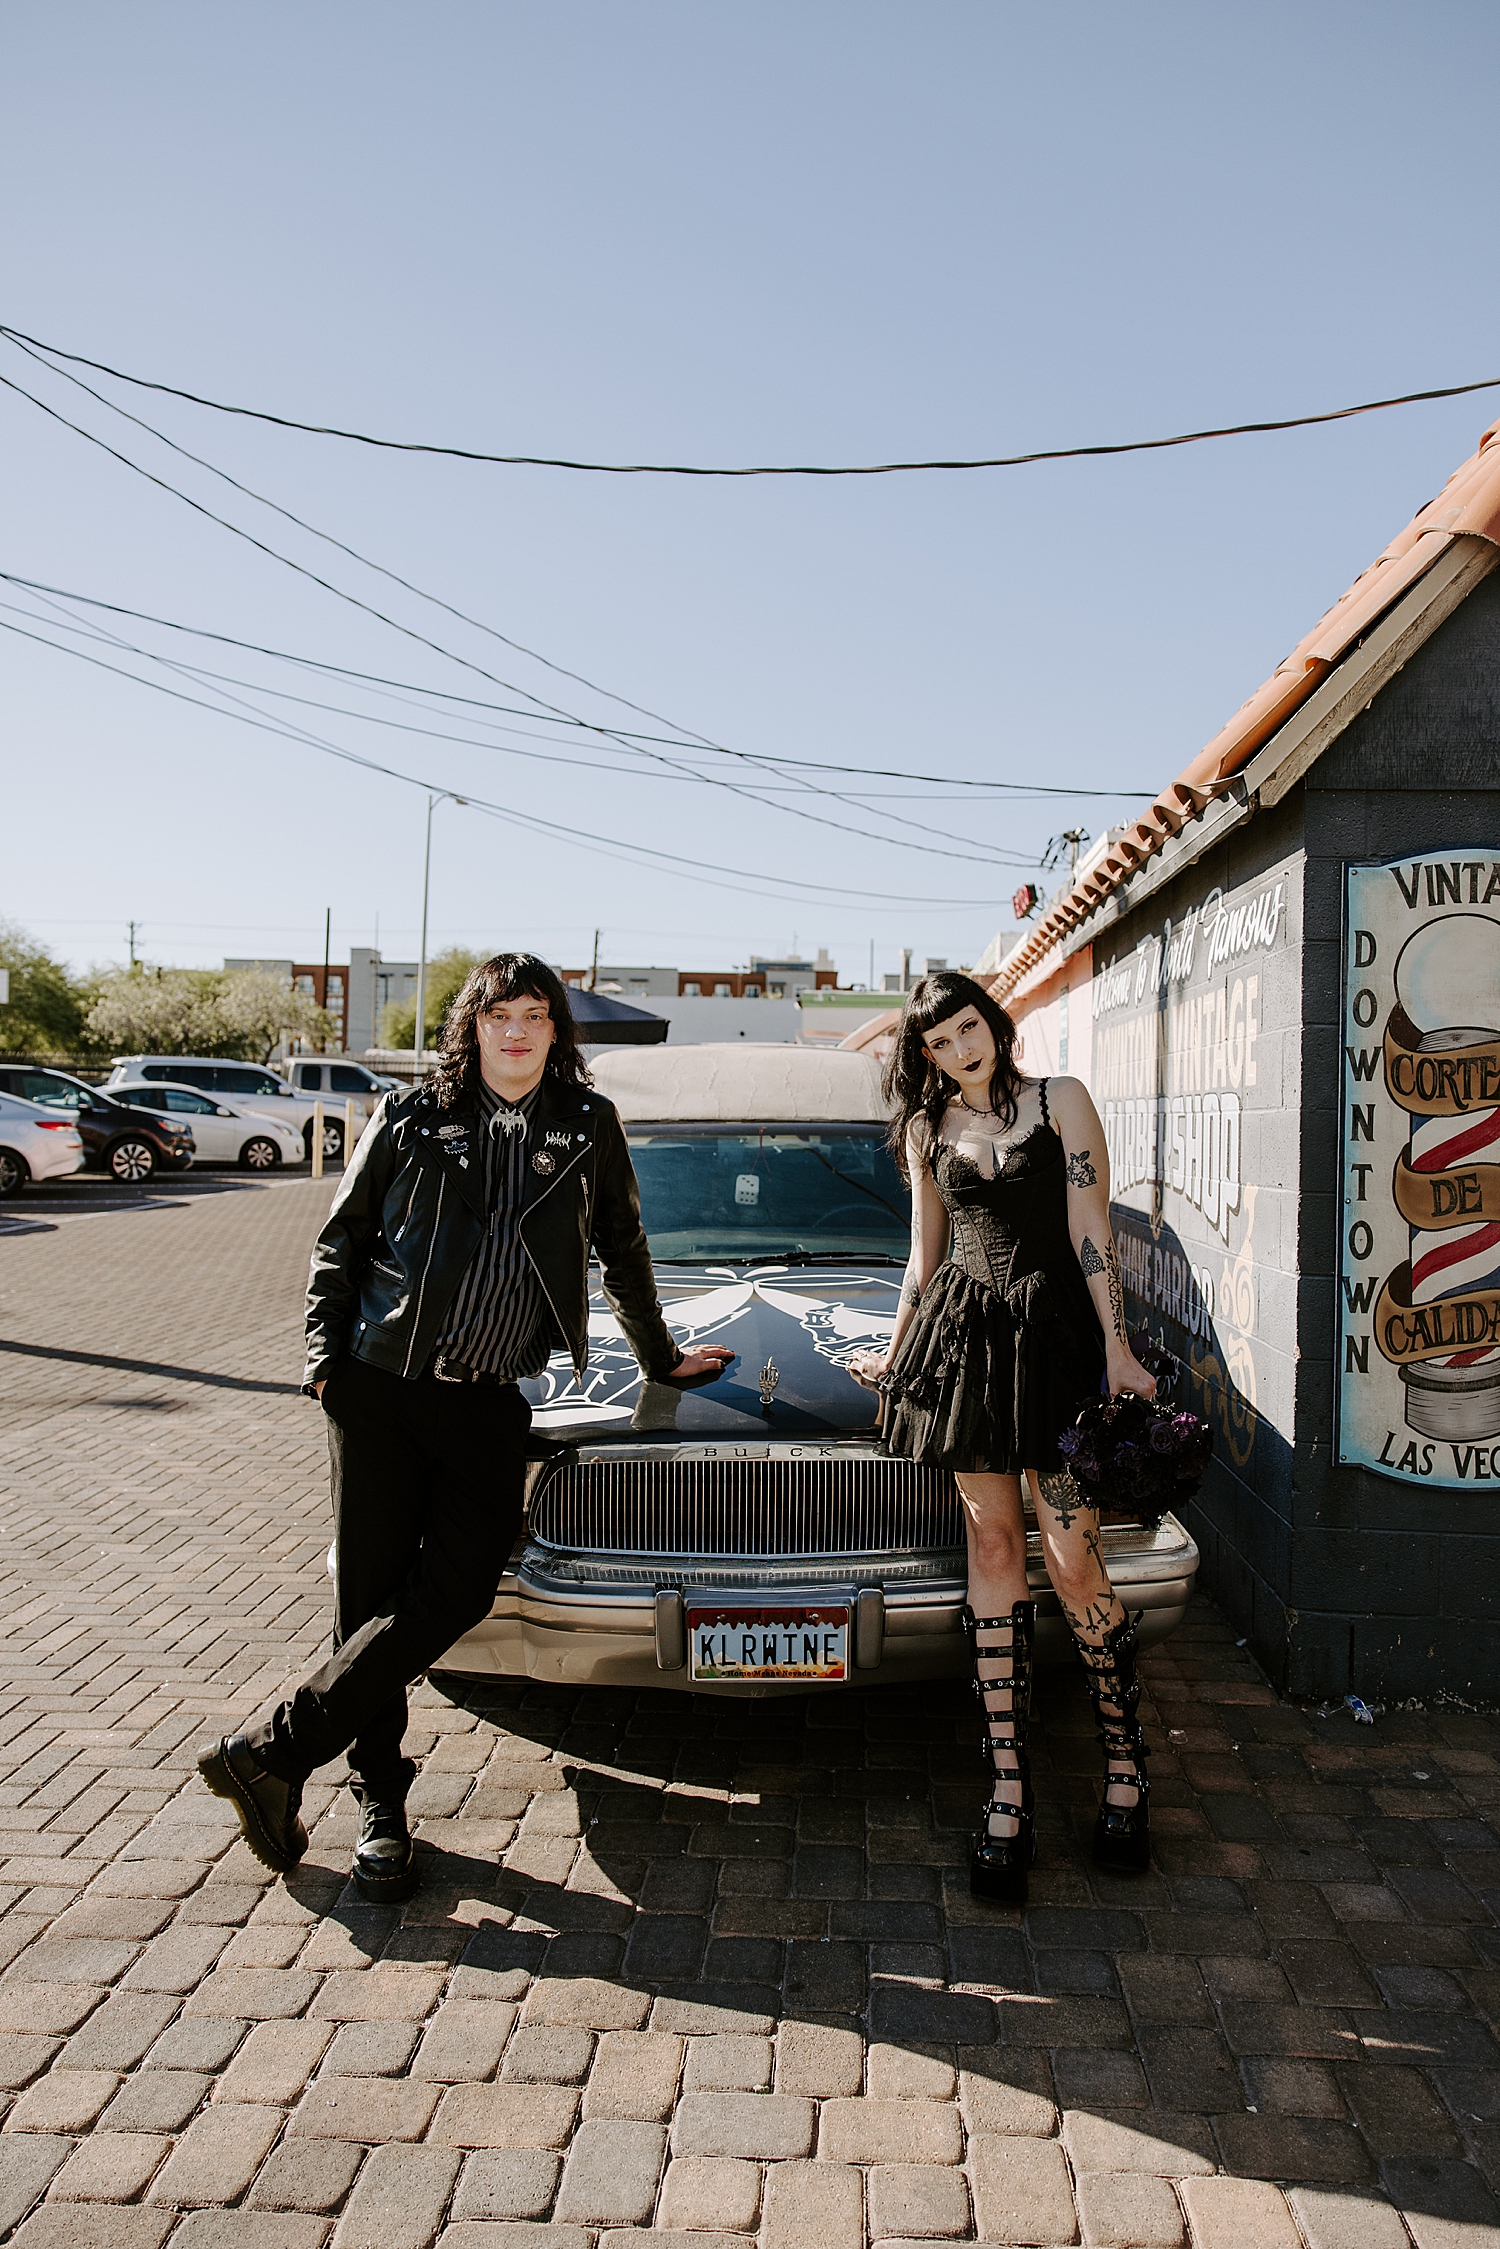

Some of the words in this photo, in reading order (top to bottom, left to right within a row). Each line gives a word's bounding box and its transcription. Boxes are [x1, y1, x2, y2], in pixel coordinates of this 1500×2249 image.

[1151, 906, 1200, 992] World
[1203, 882, 1285, 979] Famous
[1096, 1008, 1168, 1099] DOWNTOWN
[1172, 974, 1258, 1093] VINTAGE
[1391, 1054, 1500, 1110] CORTE
[1342, 931, 1382, 1374] DOWNTOWN
[1429, 1173, 1483, 1217] DE
[1154, 1246, 1214, 1342] PARLOR
[703, 1448, 833, 1457] BUICK
[1375, 1431, 1436, 1476] LAS
[701, 1633, 839, 1667] KLRWINE
